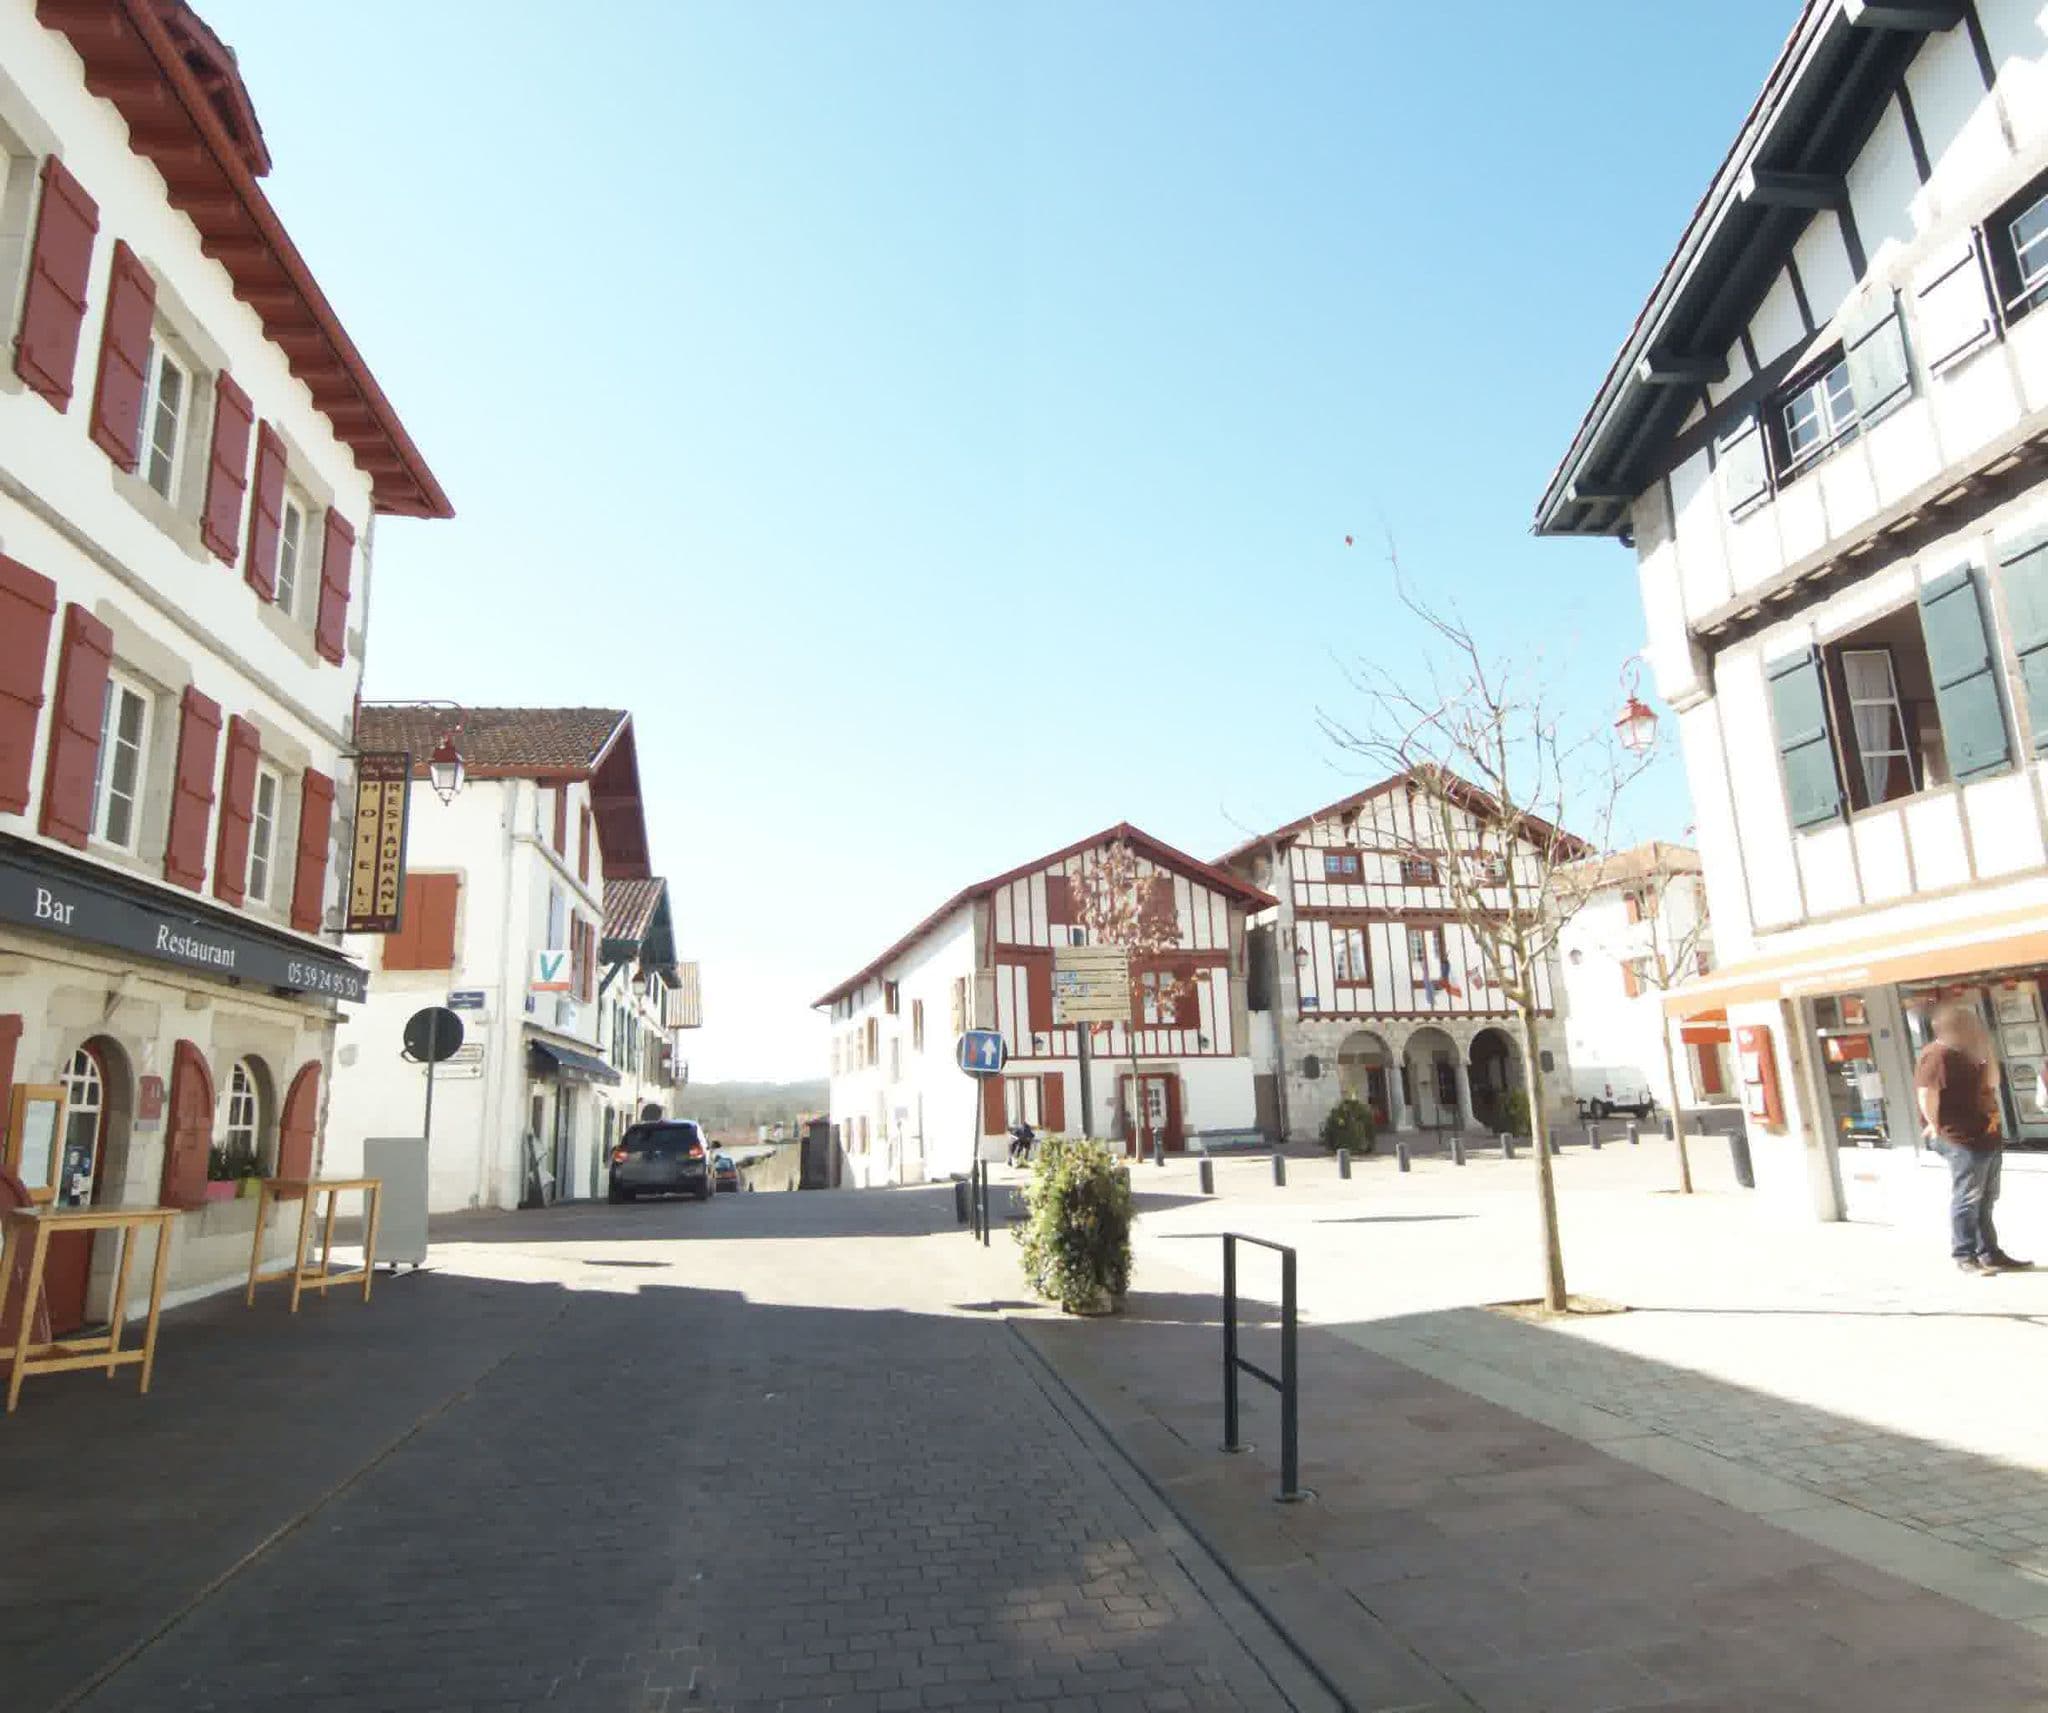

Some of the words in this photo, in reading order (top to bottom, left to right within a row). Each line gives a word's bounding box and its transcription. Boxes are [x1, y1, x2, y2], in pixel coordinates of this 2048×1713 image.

[357, 783, 378, 896] HOTEL
[381, 783, 401, 914] RESTAURANT
[34, 887, 75, 925] Bar
[156, 924, 235, 968] Restaurant
[288, 962, 302, 984] 05
[304, 966, 317, 987] 59
[319, 969, 330, 991] 24
